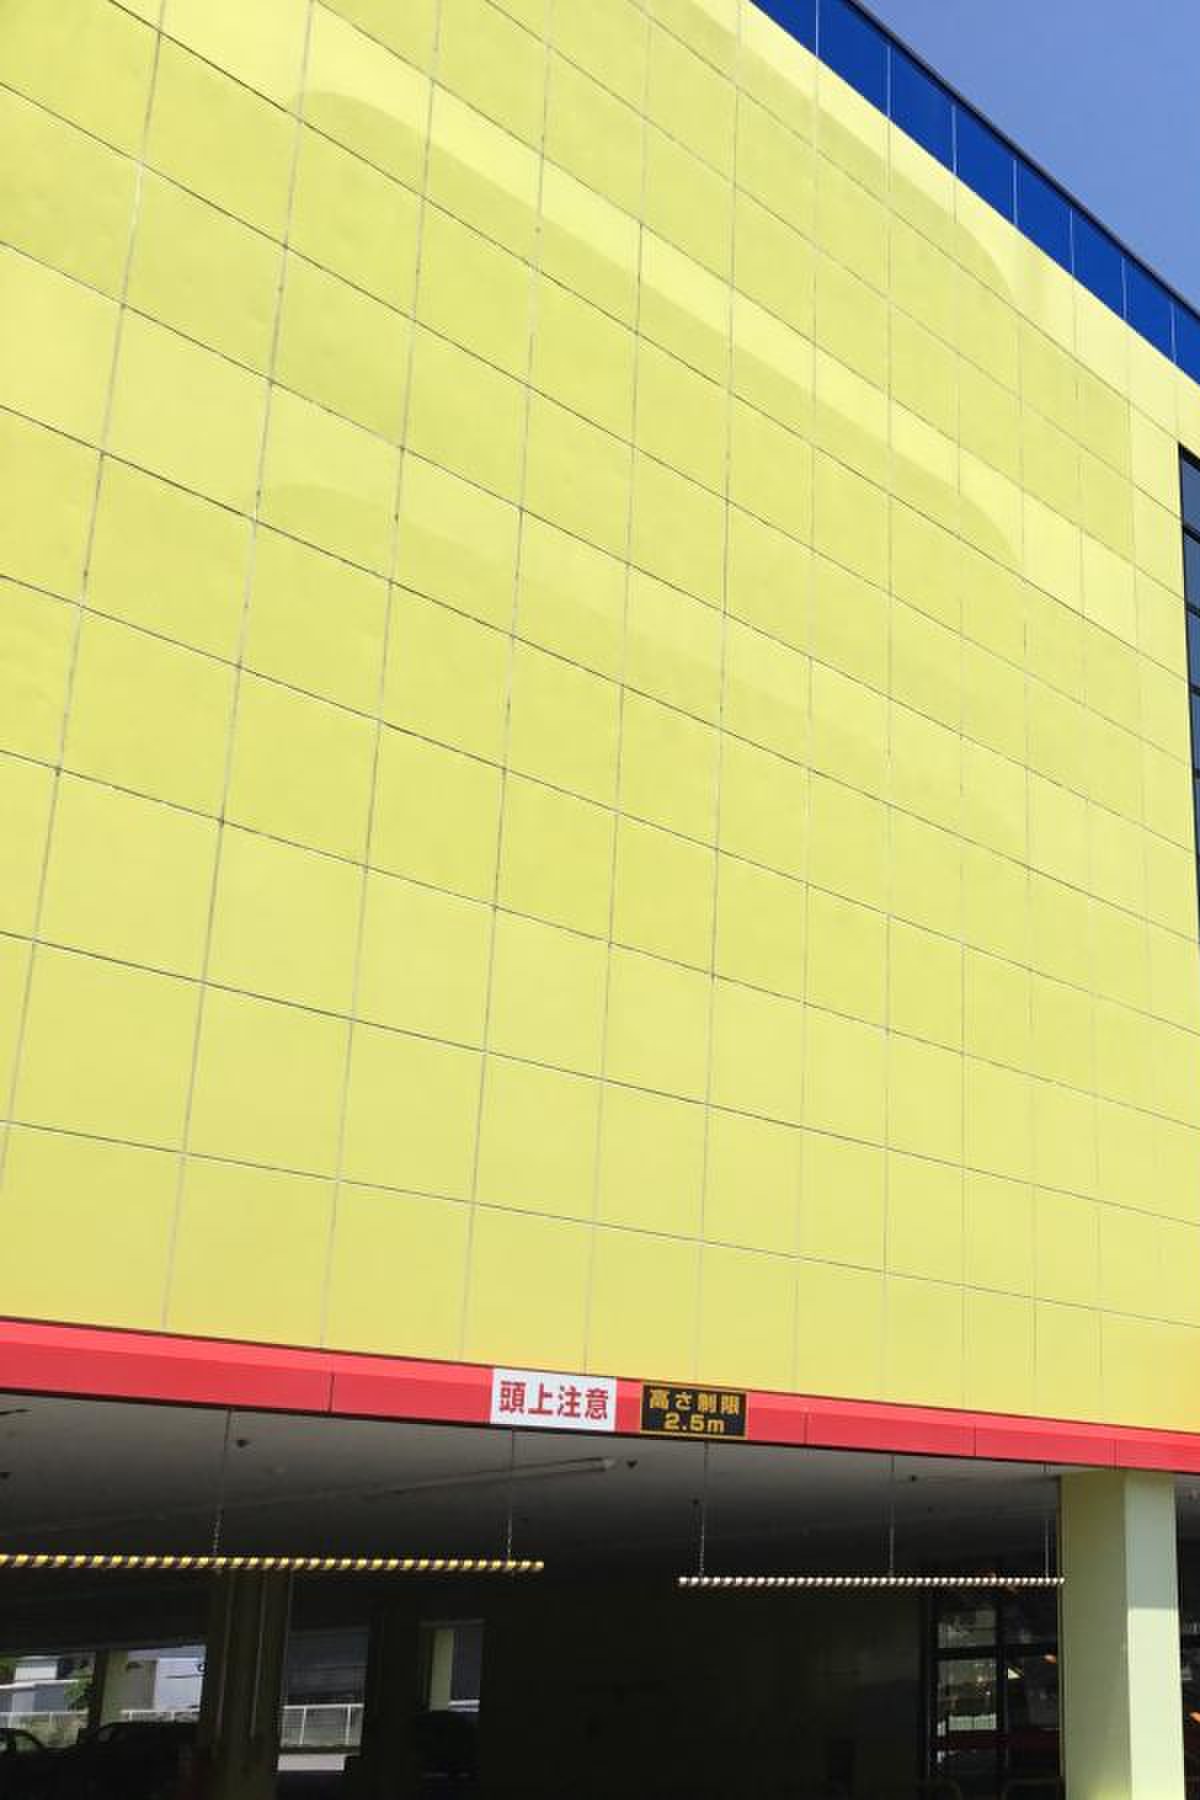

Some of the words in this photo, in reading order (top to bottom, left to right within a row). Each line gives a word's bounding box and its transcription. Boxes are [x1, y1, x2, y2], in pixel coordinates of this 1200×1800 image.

[499, 1380, 609, 1420] 頭上注意
[649, 1389, 740, 1415] 高さ制限
[664, 1412, 725, 1433] 2.5m
